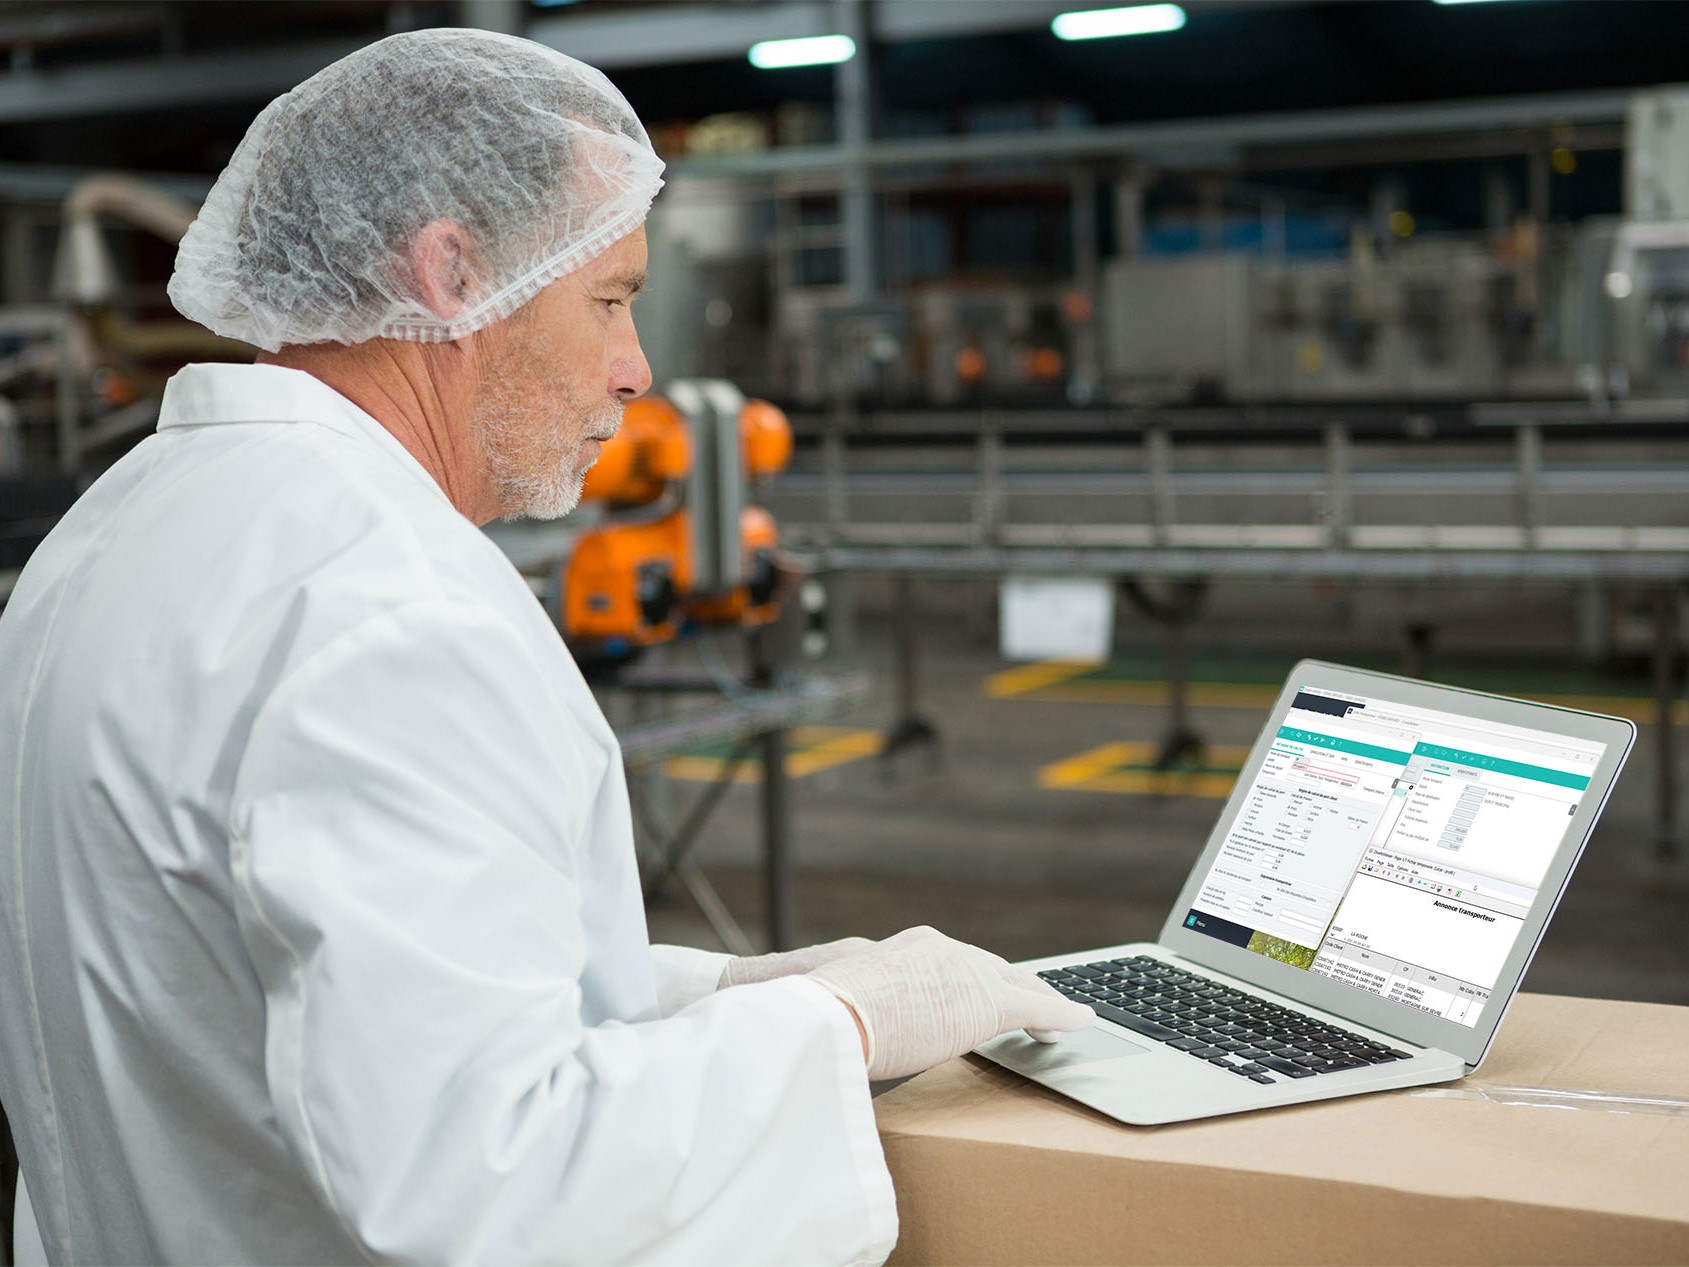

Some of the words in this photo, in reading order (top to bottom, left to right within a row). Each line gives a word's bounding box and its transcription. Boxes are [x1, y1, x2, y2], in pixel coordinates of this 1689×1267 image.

[1433, 900, 1458, 912] Annonce
[1459, 907, 1496, 923] transporteur
[1196, 920, 1207, 928] Menu
[1336, 962, 1349, 970] METRO
[1333, 968, 1346, 976] METRO
[1331, 974, 1343, 982] METRO
[1407, 986, 1425, 996] GENERAC
[1404, 992, 1422, 1002] GENERAC
